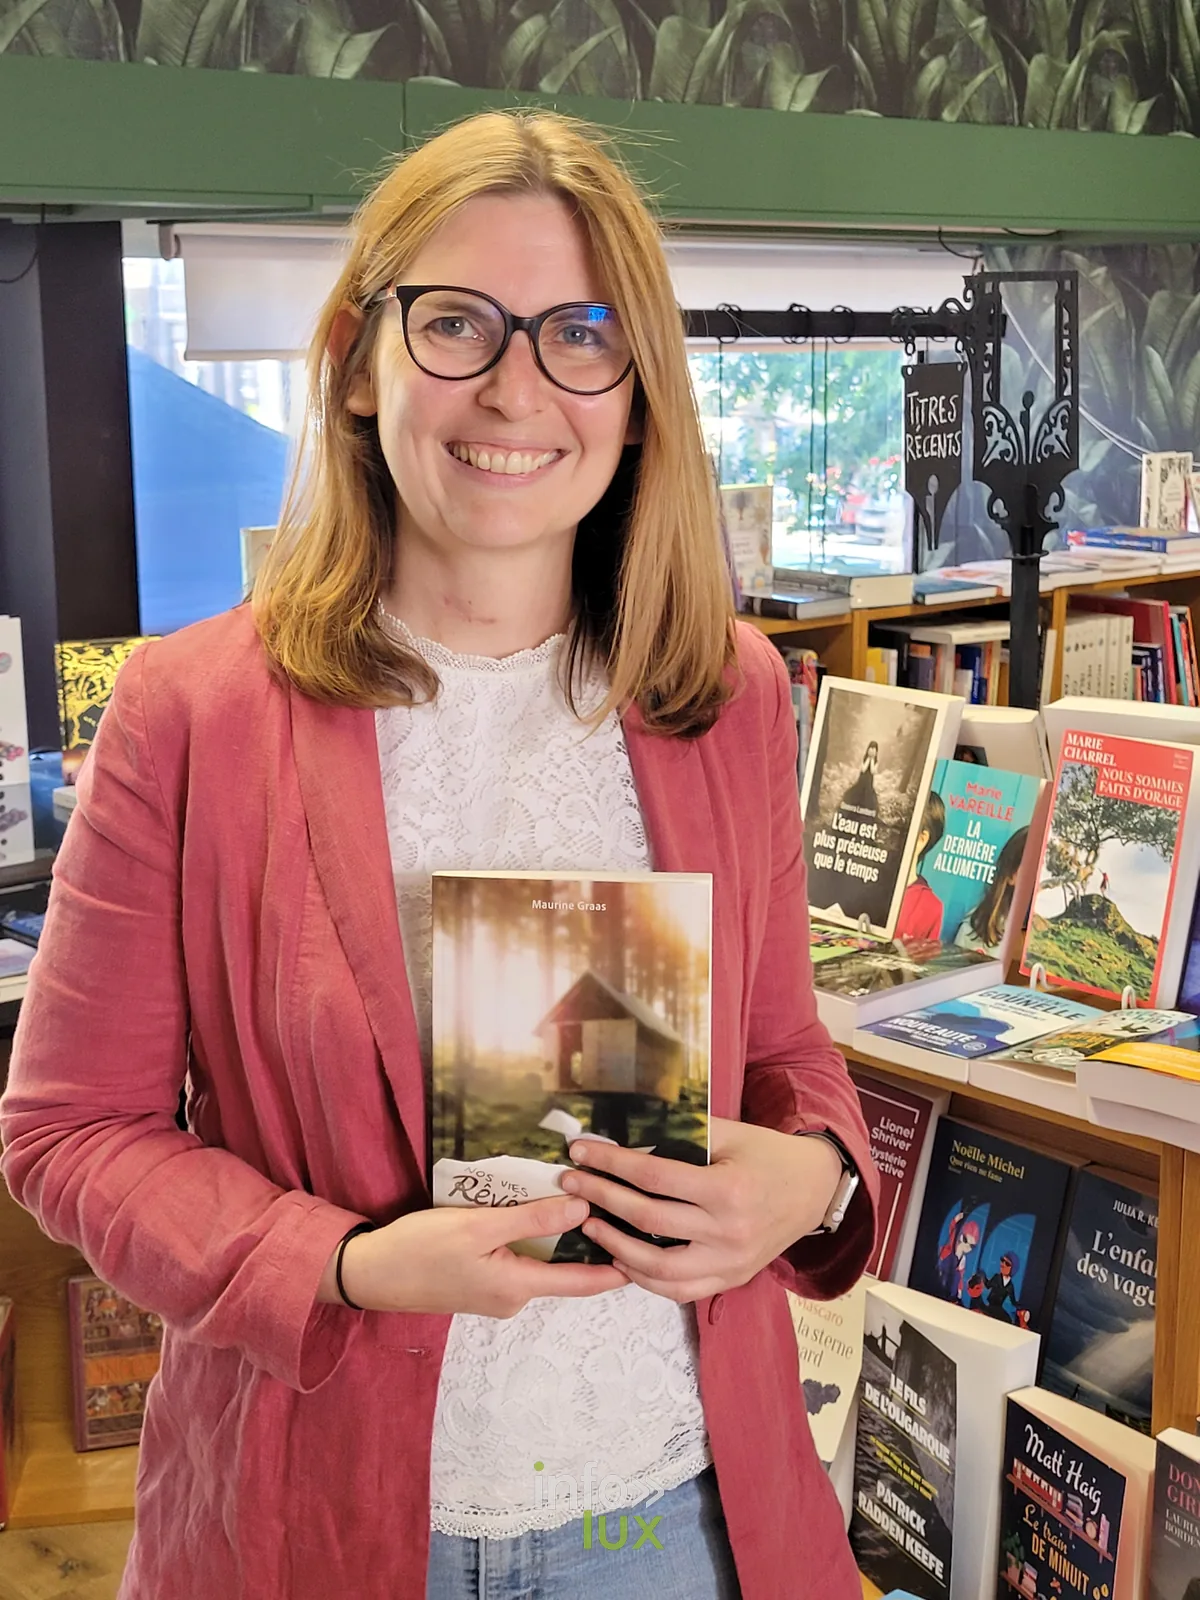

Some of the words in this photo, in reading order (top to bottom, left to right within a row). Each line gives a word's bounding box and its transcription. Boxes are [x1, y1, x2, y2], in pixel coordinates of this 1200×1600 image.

[906, 424, 962, 463] RÉCENTS
[1064, 746, 1117, 767] CHARREL
[1066, 733, 1104, 750] MARIE
[966, 782, 1003, 800] Marie
[1099, 780, 1131, 797] FAITS
[1133, 787, 1183, 808] D'ORAGE
[1101, 767, 1134, 784] NOUS
[1135, 774, 1184, 793] SOMMES
[949, 794, 1015, 822] VAREILLE
[831, 811, 859, 835] L'eau
[859, 823, 878, 840] est
[966, 820, 981, 839] LA
[813, 829, 836, 849] plus
[835, 837, 888, 863] précieuse
[943, 834, 997, 863] DERNIÈRE
[813, 852, 834, 869] que
[833, 854, 845, 872] le
[845, 858, 879, 883] temps
[933, 853, 997, 885] ALLUMETTE
[532, 899, 574, 910] Maurine
[577, 901, 607, 911] Graas
[979, 990, 1086, 1021] GOUNELLE
[887, 1017, 978, 1043] NOUVEAUTÉ
[871, 1127, 912, 1151] Shriver
[880, 1116, 915, 1140] Lionel
[872, 1160, 905, 1179] ective
[949, 1155, 963, 1167] Que
[963, 1162, 978, 1173] rien
[952, 1140, 986, 1163] Noëlle
[987, 1153, 1025, 1179] Michel
[464, 1167, 494, 1182] NOS
[500, 1180, 529, 1197] VIES
[1113, 1200, 1136, 1219] JULIA
[1137, 1210, 1146, 1223] R.
[1076, 1252, 1109, 1284] des
[1092, 1229, 1158, 1278] L'enfa
[797, 1316, 810, 1339] la
[811, 1328, 854, 1360] sterne
[800, 1346, 824, 1368] ard
[889, 1373, 904, 1398] LE
[903, 1383, 927, 1416] FILS
[865, 1381, 880, 1408] DE
[880, 1394, 950, 1467] L'OLIGARQUE
[1024, 1423, 1065, 1478] Matt
[1065, 1460, 1102, 1515] Haig
[876, 1479, 927, 1537] PATRICK
[1167, 1484, 1200, 1518] GIR
[858, 1490, 905, 1547] RADDEN
[905, 1533, 944, 1580] KEEFE
[1023, 1504, 1040, 1531] Le
[1043, 1520, 1069, 1555] train
[1031, 1534, 1046, 1562] DE
[1048, 1549, 1090, 1596] MINUIT
